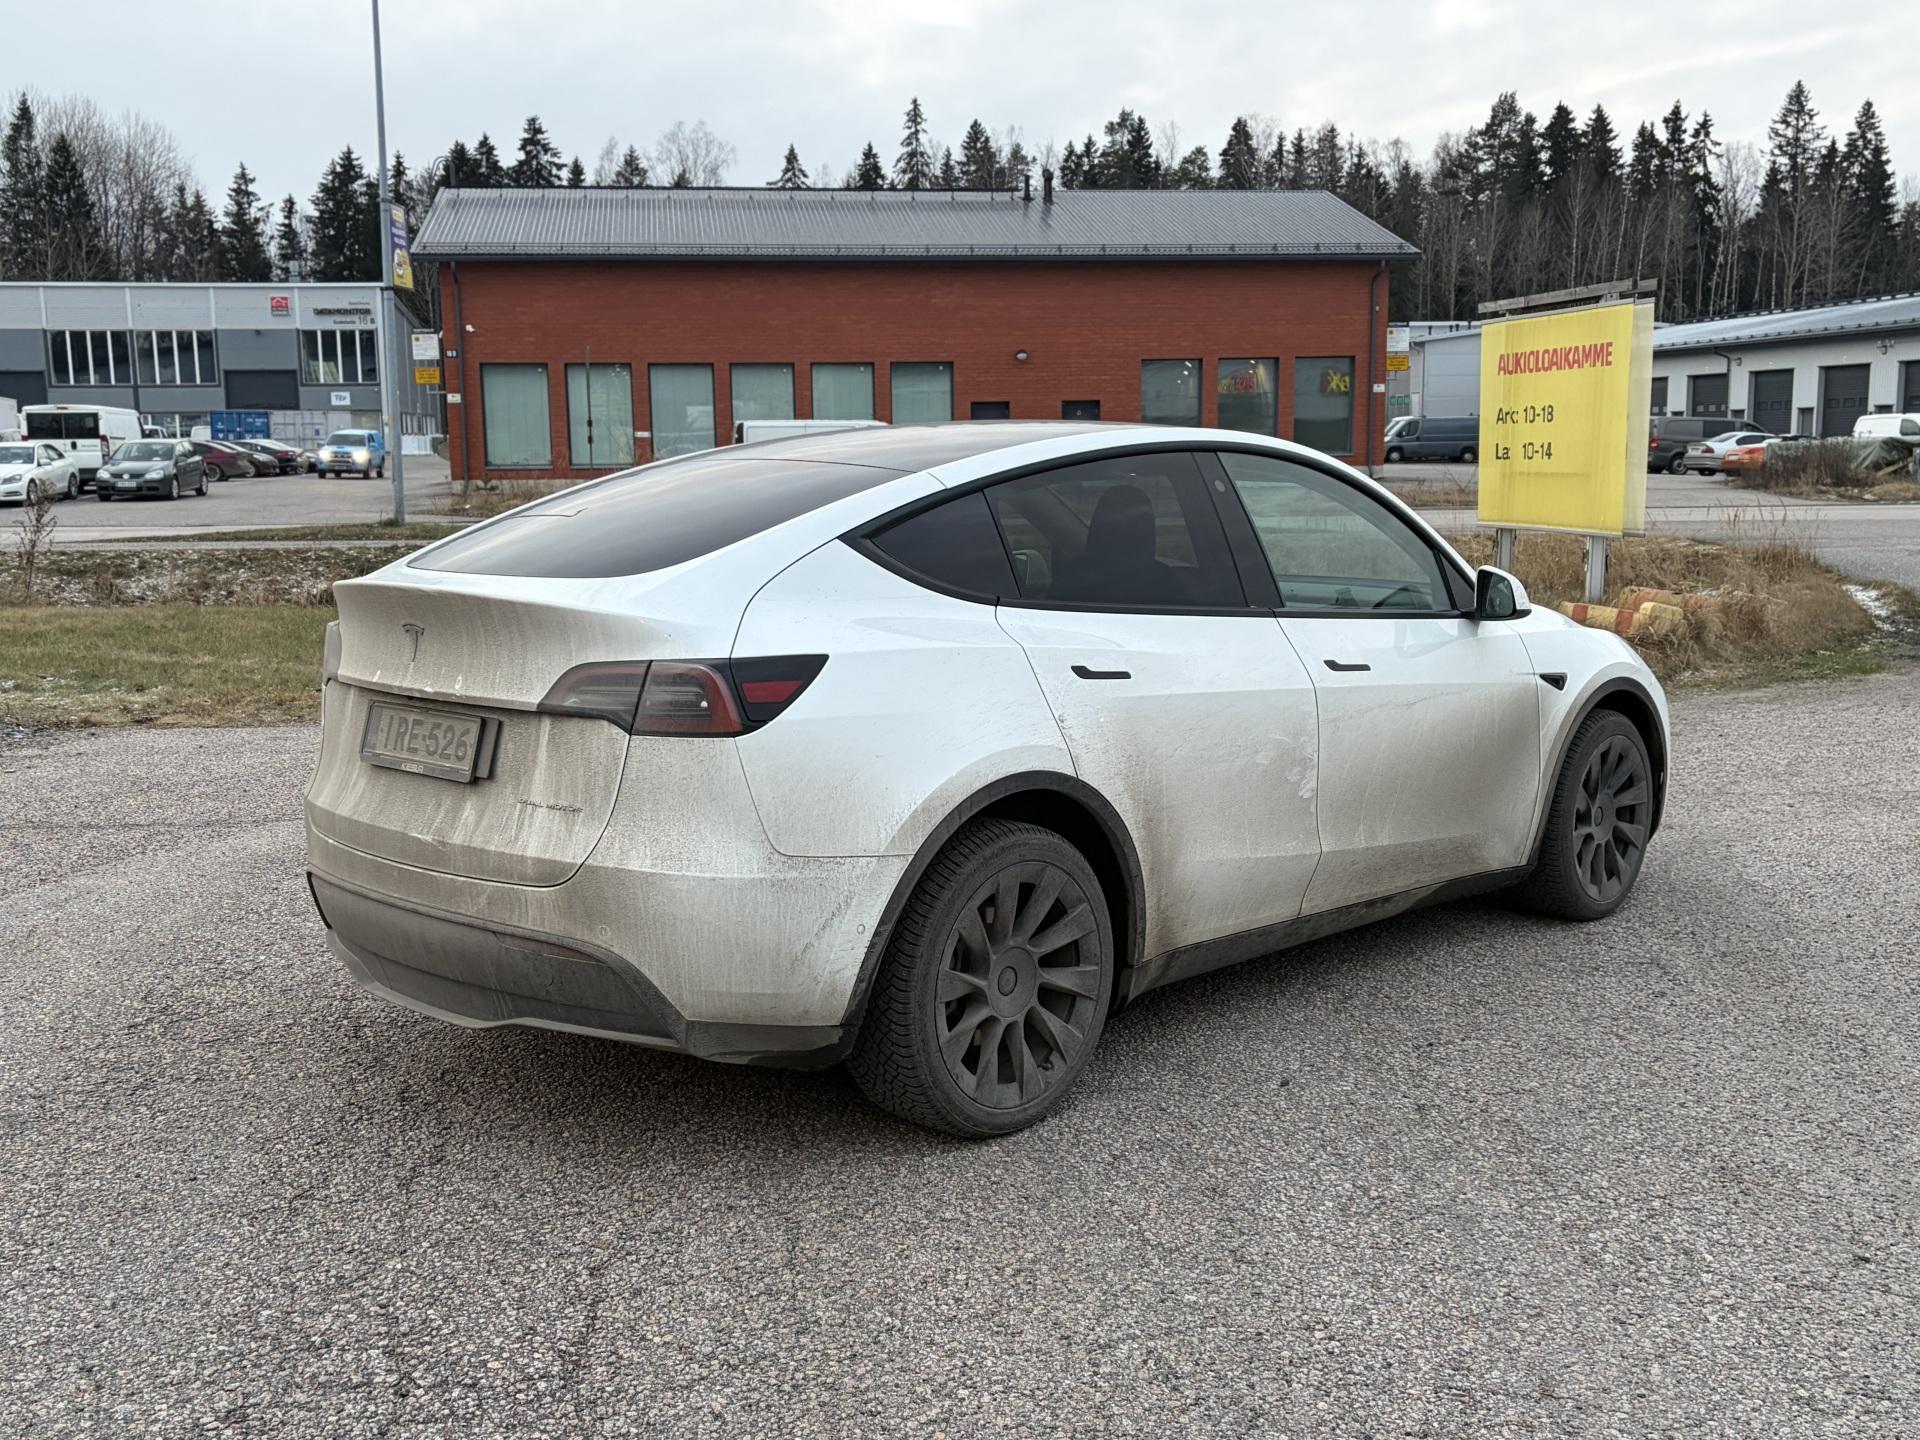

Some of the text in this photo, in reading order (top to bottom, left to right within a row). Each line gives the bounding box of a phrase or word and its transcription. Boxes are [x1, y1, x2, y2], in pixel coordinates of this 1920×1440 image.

[1497, 341, 1614, 376] AUKIOLOAIKAMME
[1523, 404, 1555, 423] 10-18
[1522, 441, 1553, 460] 10-14
